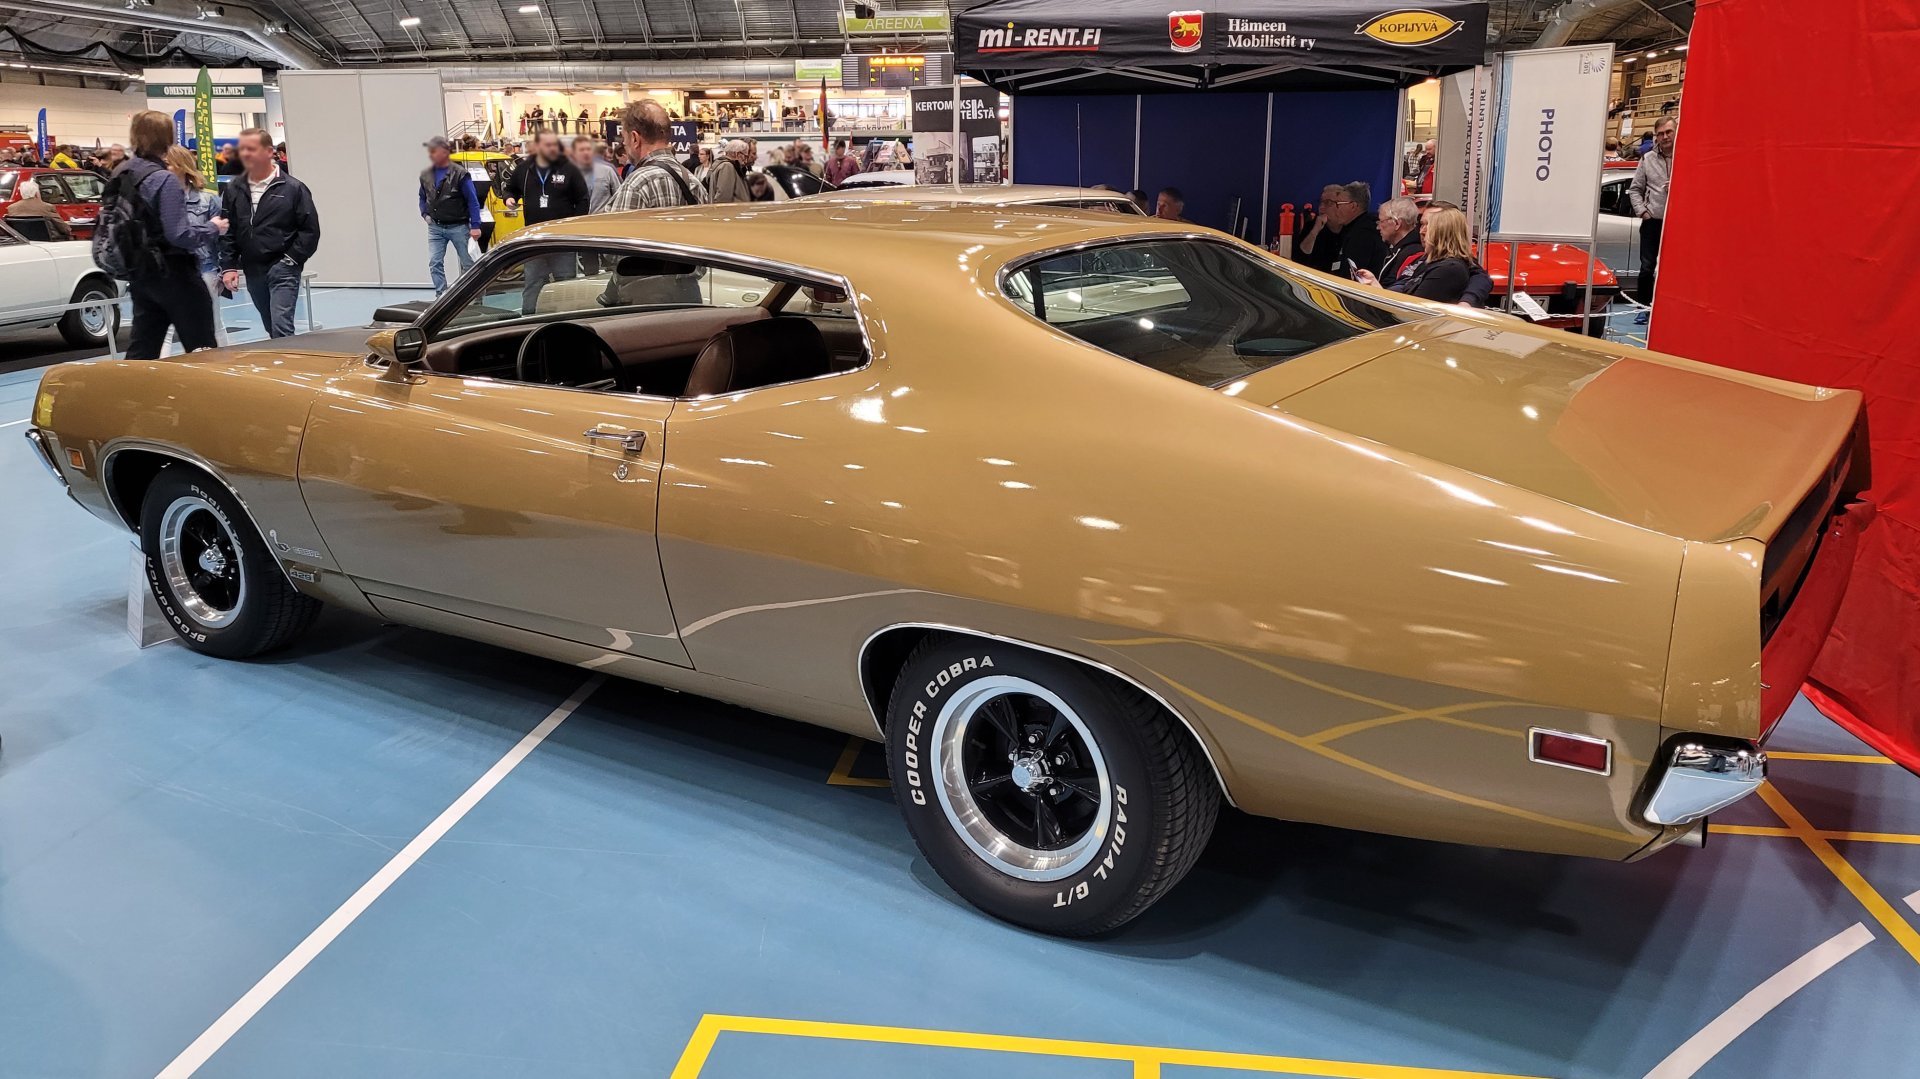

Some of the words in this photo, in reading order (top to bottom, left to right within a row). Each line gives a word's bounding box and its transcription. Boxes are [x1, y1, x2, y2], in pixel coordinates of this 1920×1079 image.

[864, 18, 924, 30] AREENA
[978, 22, 1101, 47] mi-RENT.FI
[1228, 18, 1287, 32] Hämeen
[1379, 20, 1438, 33] KOPIJYVÄ
[1227, 34, 1296, 48] Mobilistit
[1300, 38, 1316, 51] ry
[915, 99, 984, 112] KERTOMKSIA
[1535, 108, 1556, 182] PHOTO
[1461, 159, 1470, 212] ENTRANCE
[905, 701, 928, 806] COOPER
[925, 655, 995, 699] COBRA
[1093, 783, 1128, 881] RADIAL
[1052, 881, 1090, 909] G/T
